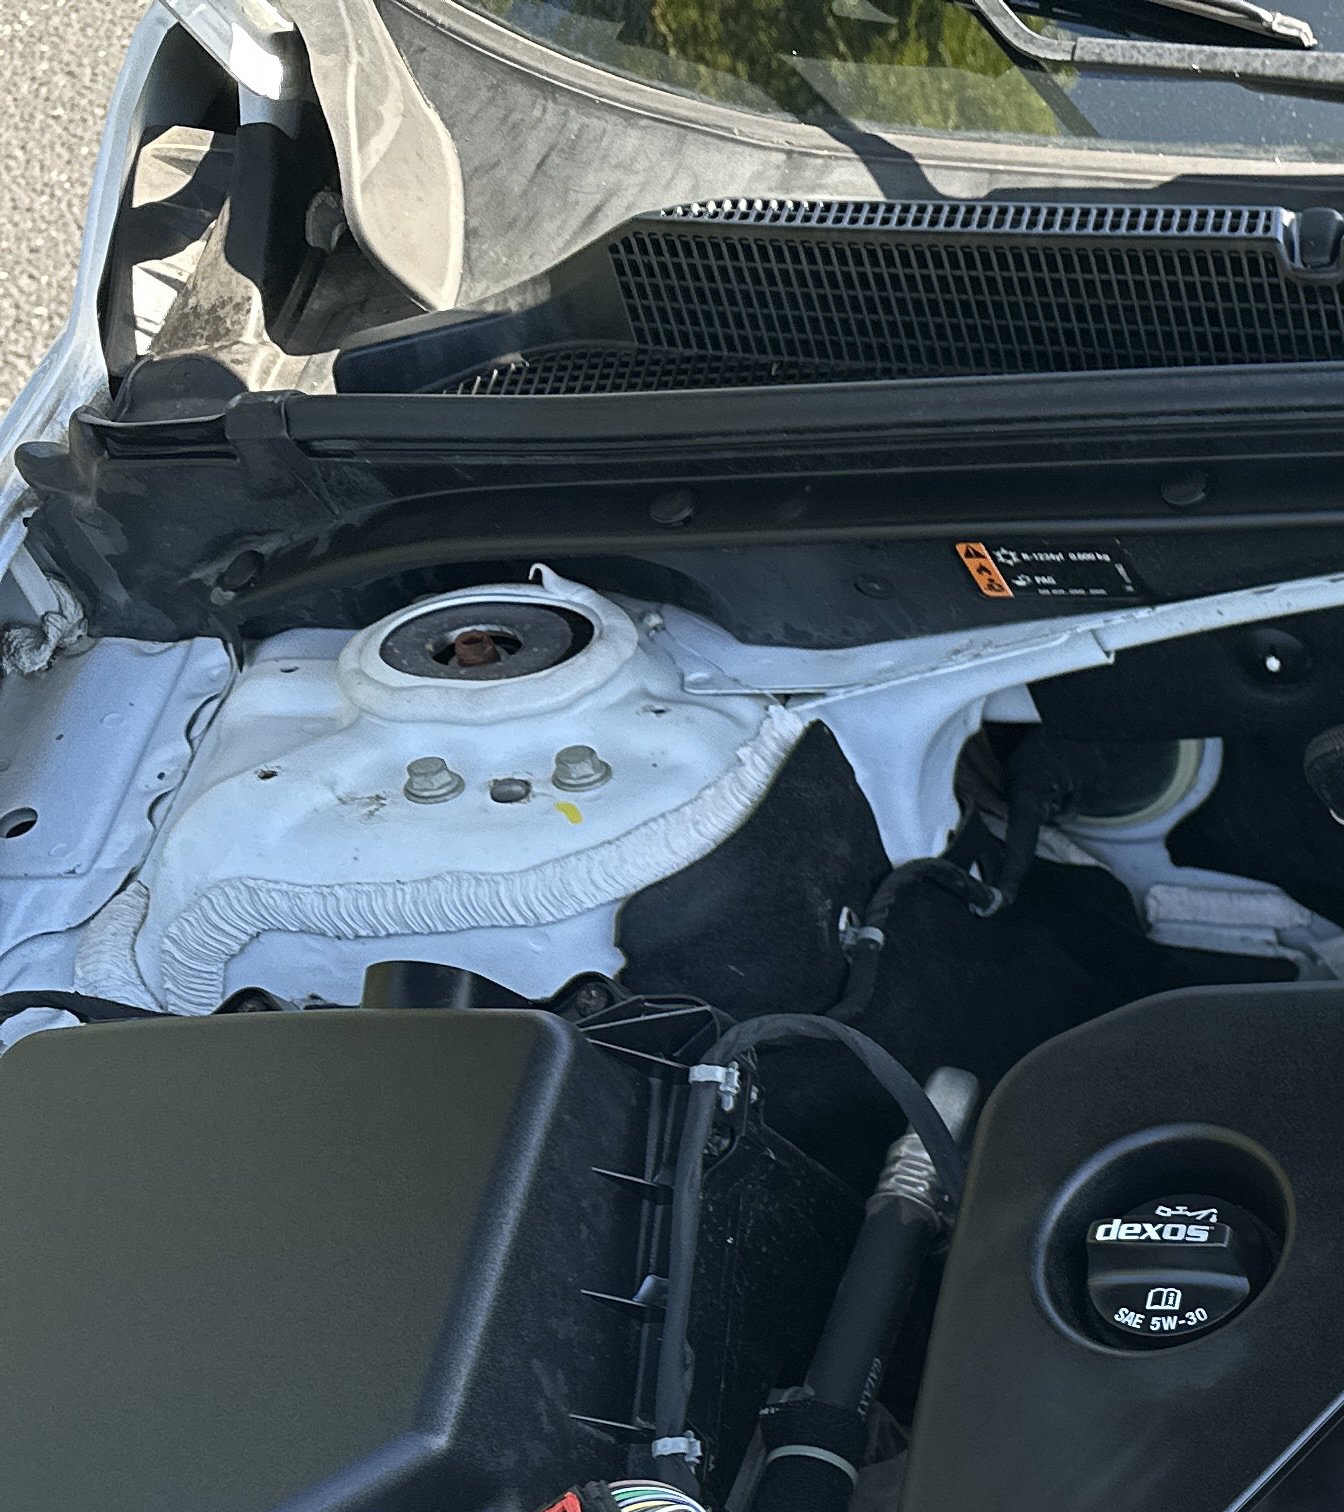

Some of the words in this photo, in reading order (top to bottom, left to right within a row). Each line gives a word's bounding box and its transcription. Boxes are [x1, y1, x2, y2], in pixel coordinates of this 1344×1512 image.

[1095, 1218, 1209, 1242] dexos
[1113, 1307, 1145, 1329] SAE
[1149, 1307, 1208, 1331] 5W-30
